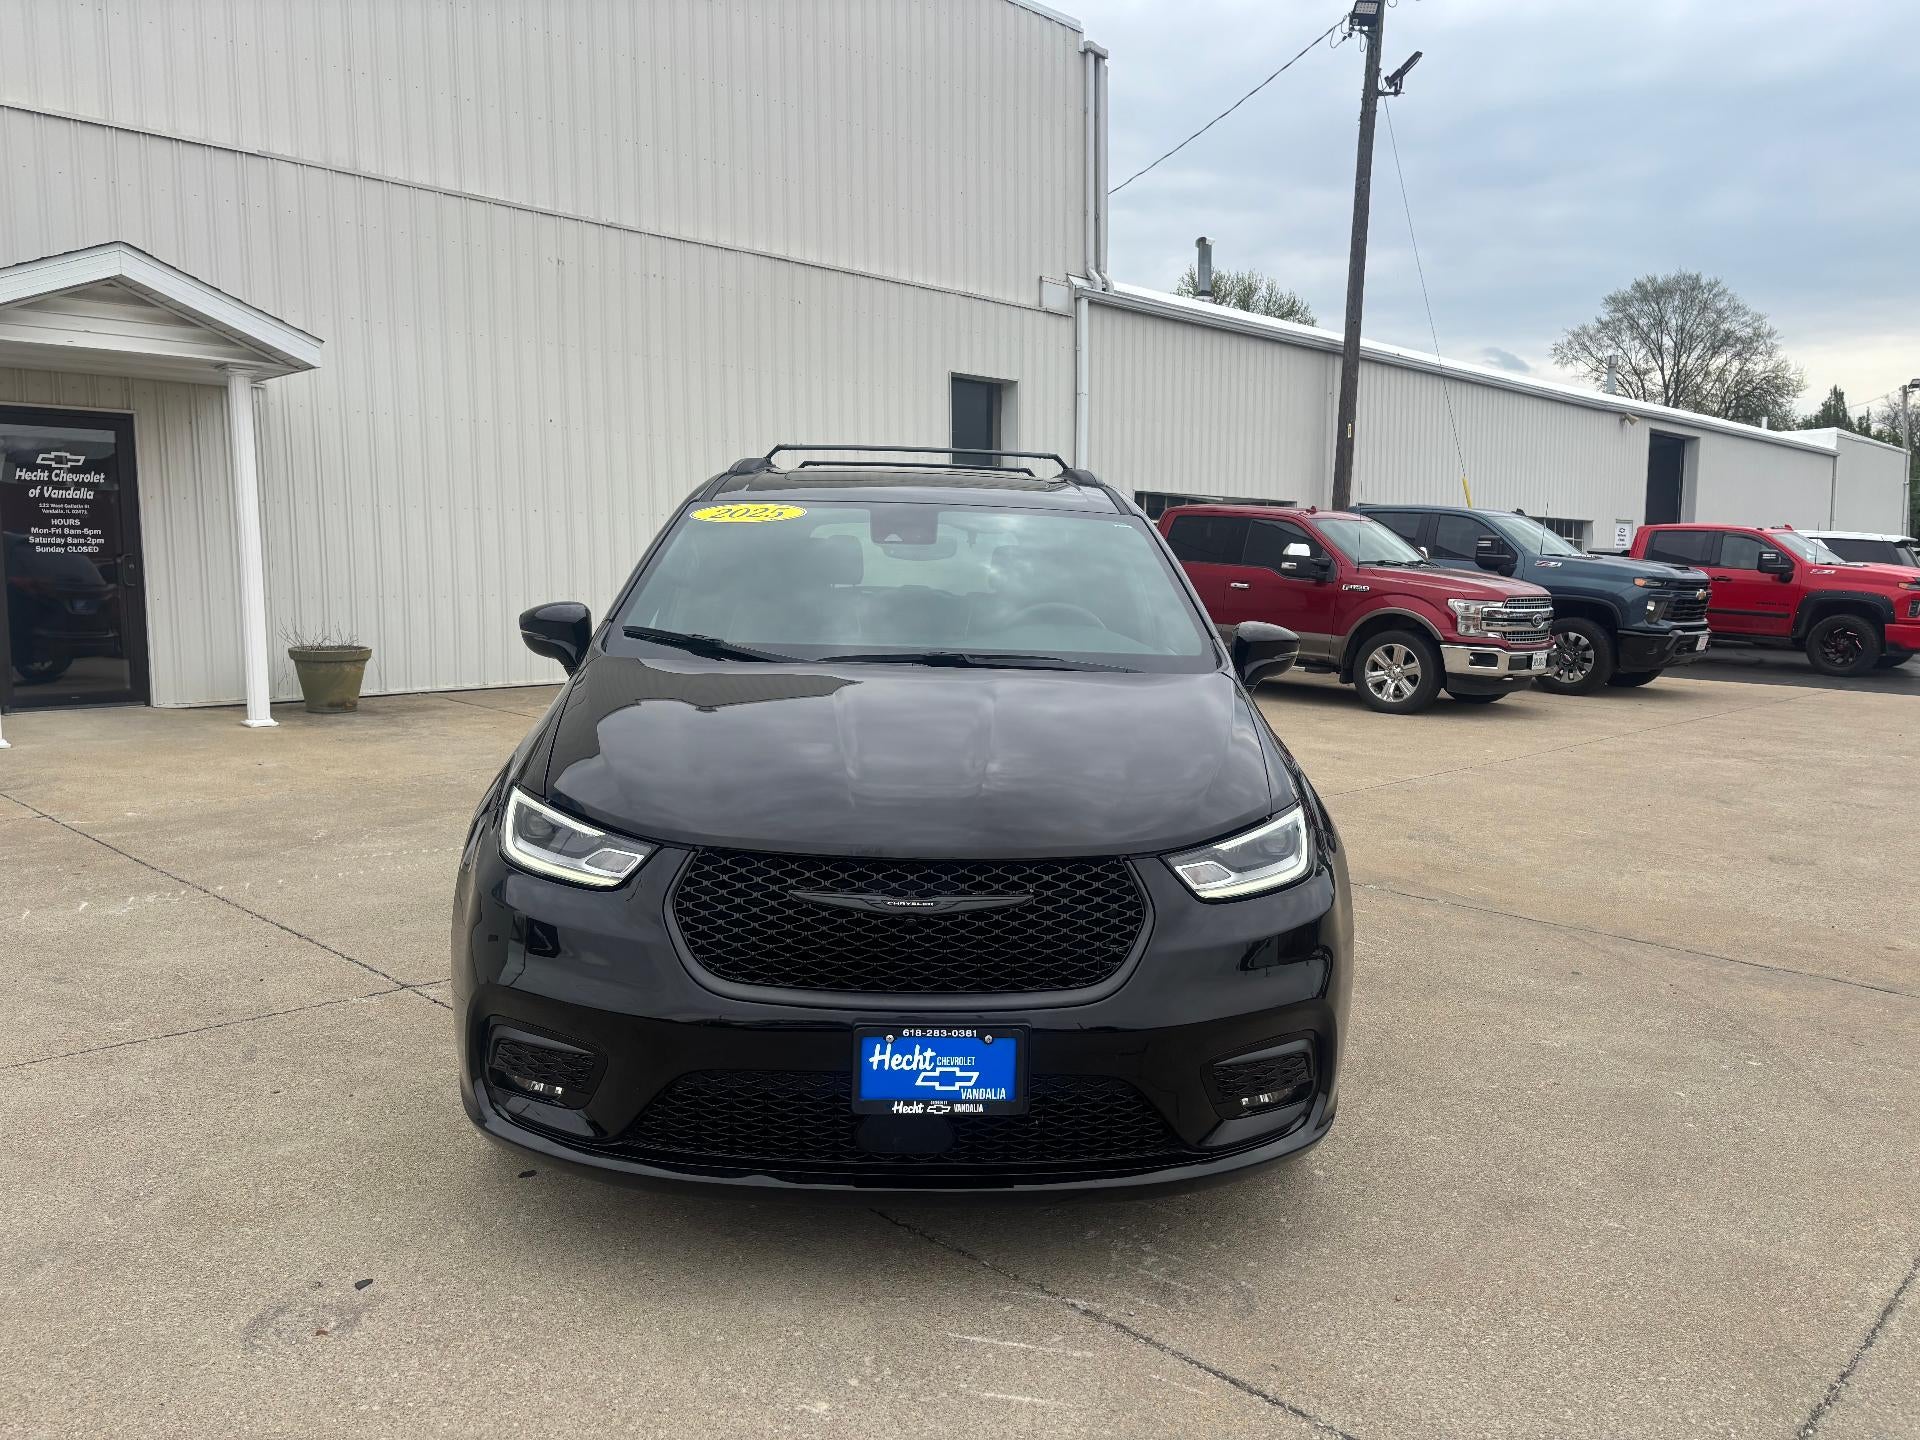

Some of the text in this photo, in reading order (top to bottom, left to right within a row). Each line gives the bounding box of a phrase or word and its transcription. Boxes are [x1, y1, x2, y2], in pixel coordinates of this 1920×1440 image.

[15, 468, 105, 483] Hecht Chevrolet
[28, 486, 95, 499] of Vandalia
[709, 507, 790, 521] 2025
[51, 518, 81, 526] HOURS
[28, 536, 105, 545] Saturday 8am-2pm
[35, 545, 65, 554] Sunday
[902, 1028, 977, 1038] 618-283-0381
[868, 1043, 976, 1071] Hecht CHEVROLET
[961, 1087, 1007, 1100] VANDALIA
[891, 1100, 925, 1114] Hecht
[954, 1103, 984, 1113] VANDALIA
